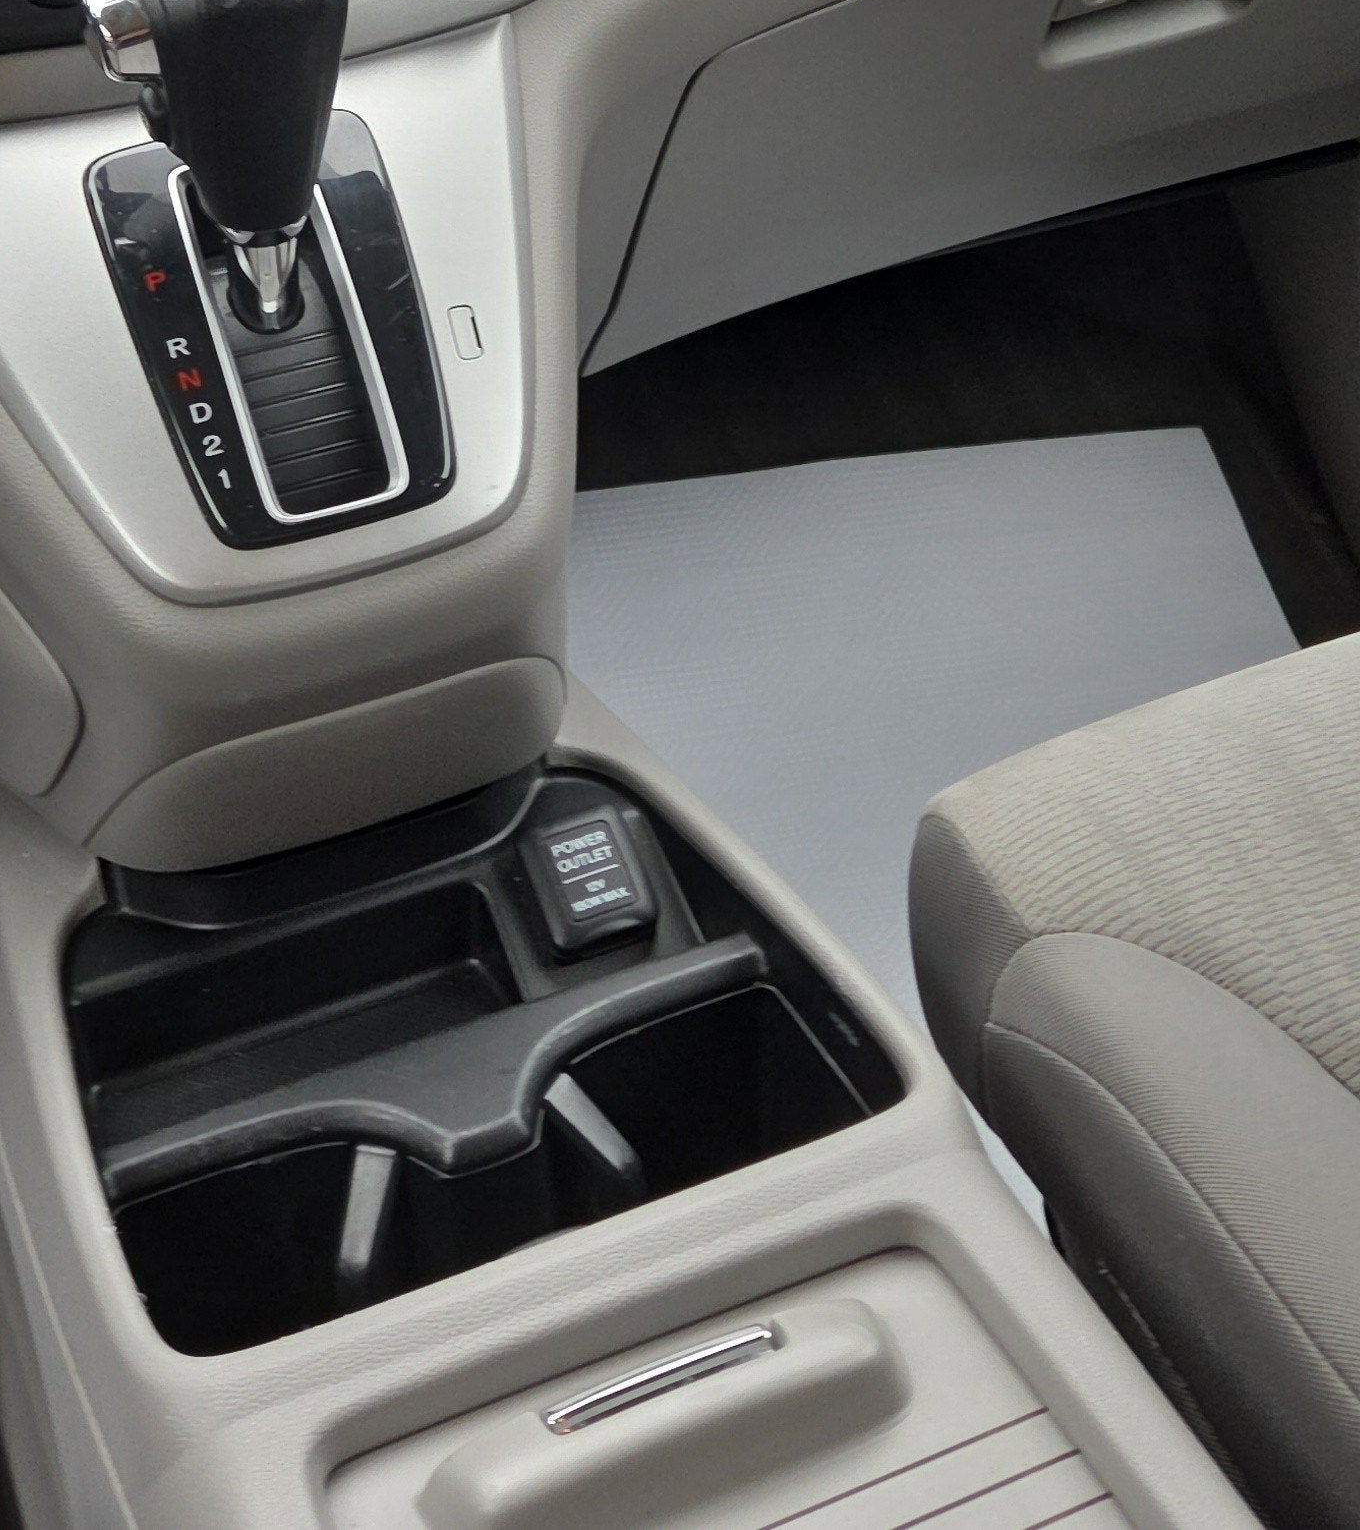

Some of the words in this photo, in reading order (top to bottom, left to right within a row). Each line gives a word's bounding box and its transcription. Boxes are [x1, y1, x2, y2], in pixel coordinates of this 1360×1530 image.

[145, 272, 166, 292] P
[166, 338, 190, 359] R
[176, 368, 202, 390] N
[189, 403, 213, 425] D
[202, 435, 225, 456] 2
[217, 469, 232, 490] 1
[550, 830, 609, 858] POWER
[556, 845, 613, 874] OUTLET
